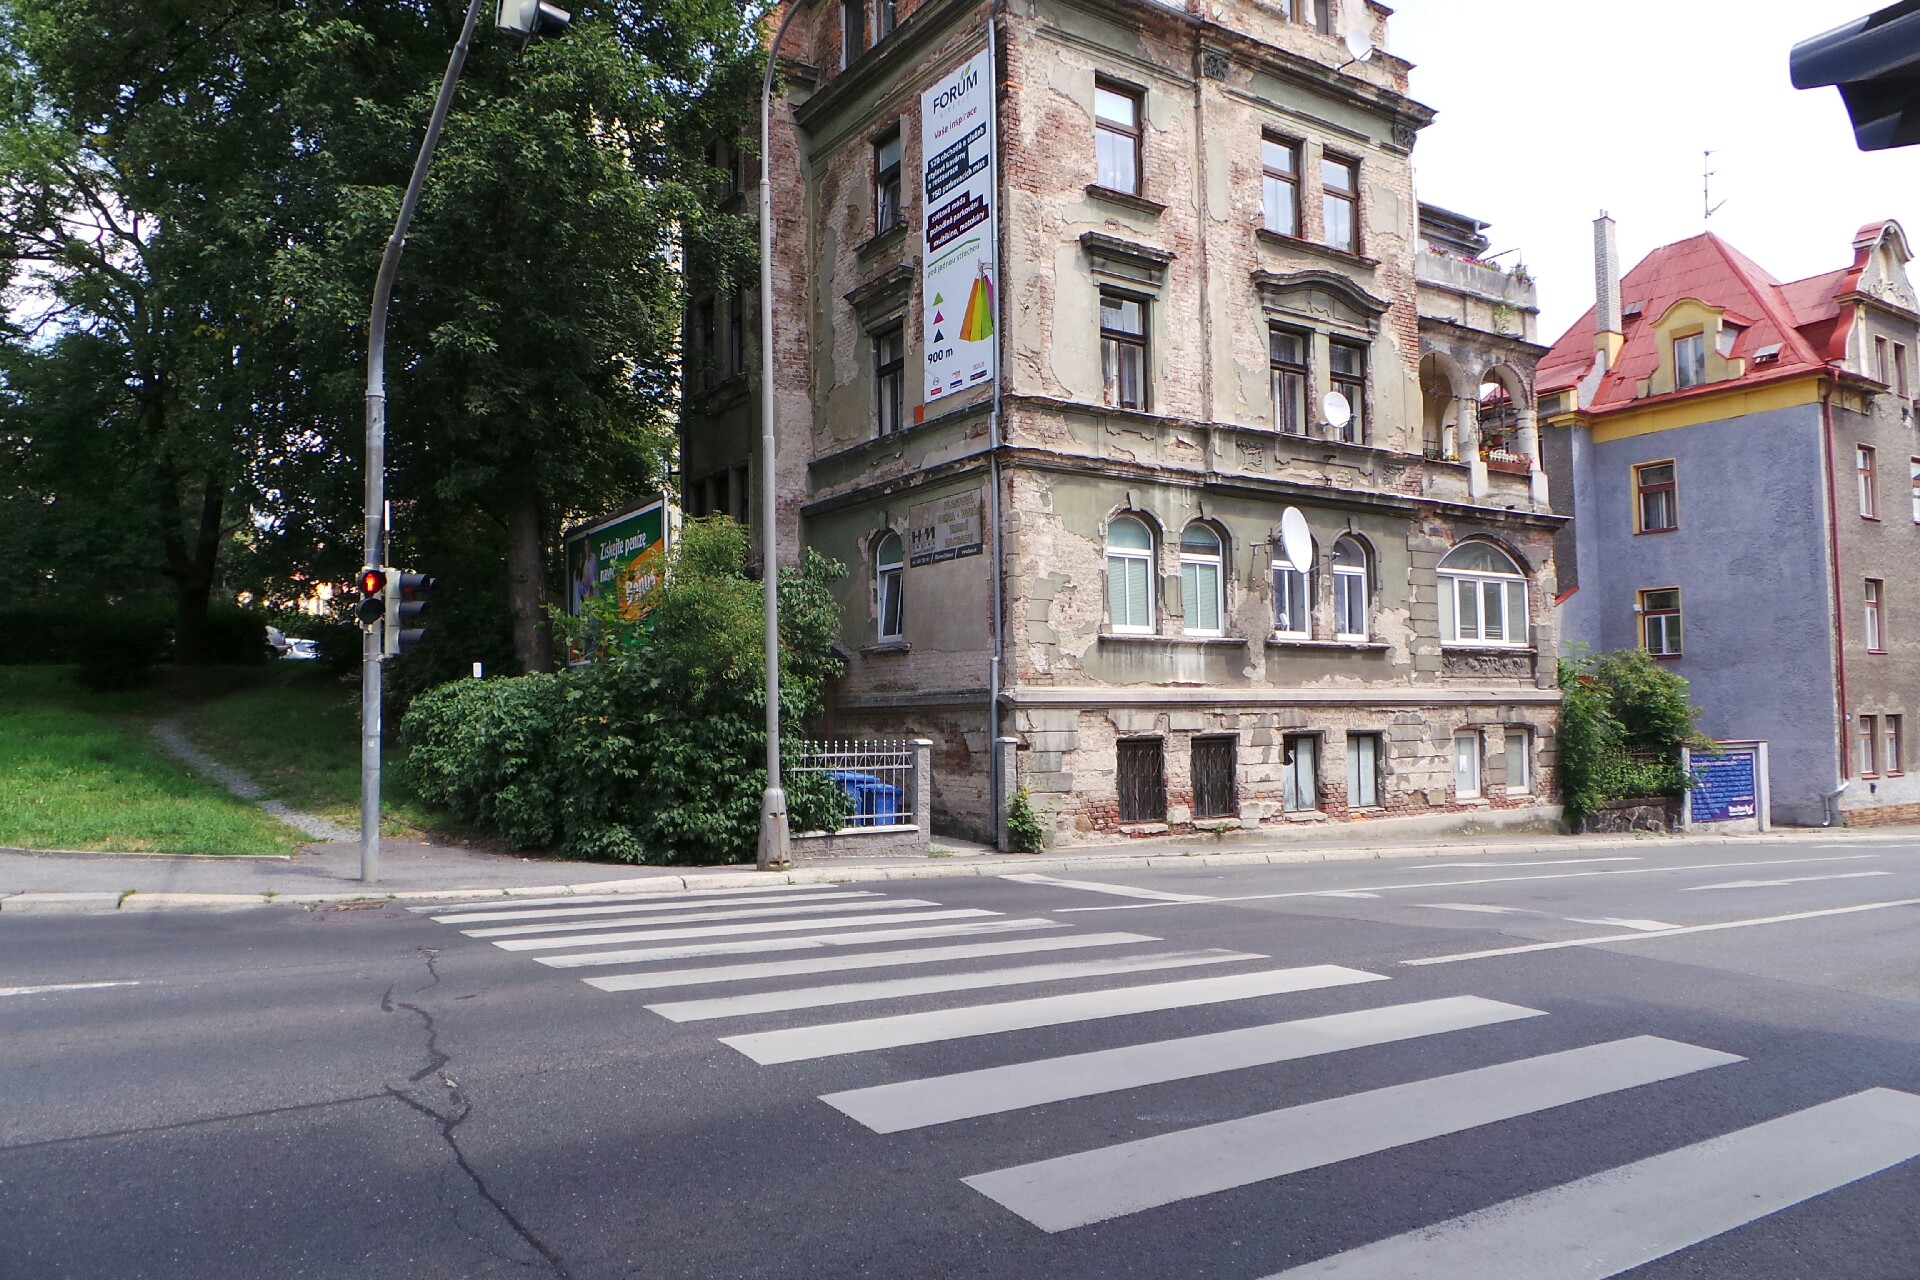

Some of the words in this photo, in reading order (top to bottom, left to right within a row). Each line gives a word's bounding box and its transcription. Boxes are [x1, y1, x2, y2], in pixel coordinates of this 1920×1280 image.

[933, 70, 978, 114] FORUM
[934, 125, 949, 139] Vaše
[949, 106, 978, 130] inspirace
[930, 156, 940, 169] 120
[932, 164, 959, 187] restaurace
[931, 187, 942, 200] 750
[928, 349, 944, 365] 900
[945, 348, 953, 358] m
[600, 537, 624, 560] Získejte
[625, 530, 647, 556] peníze
